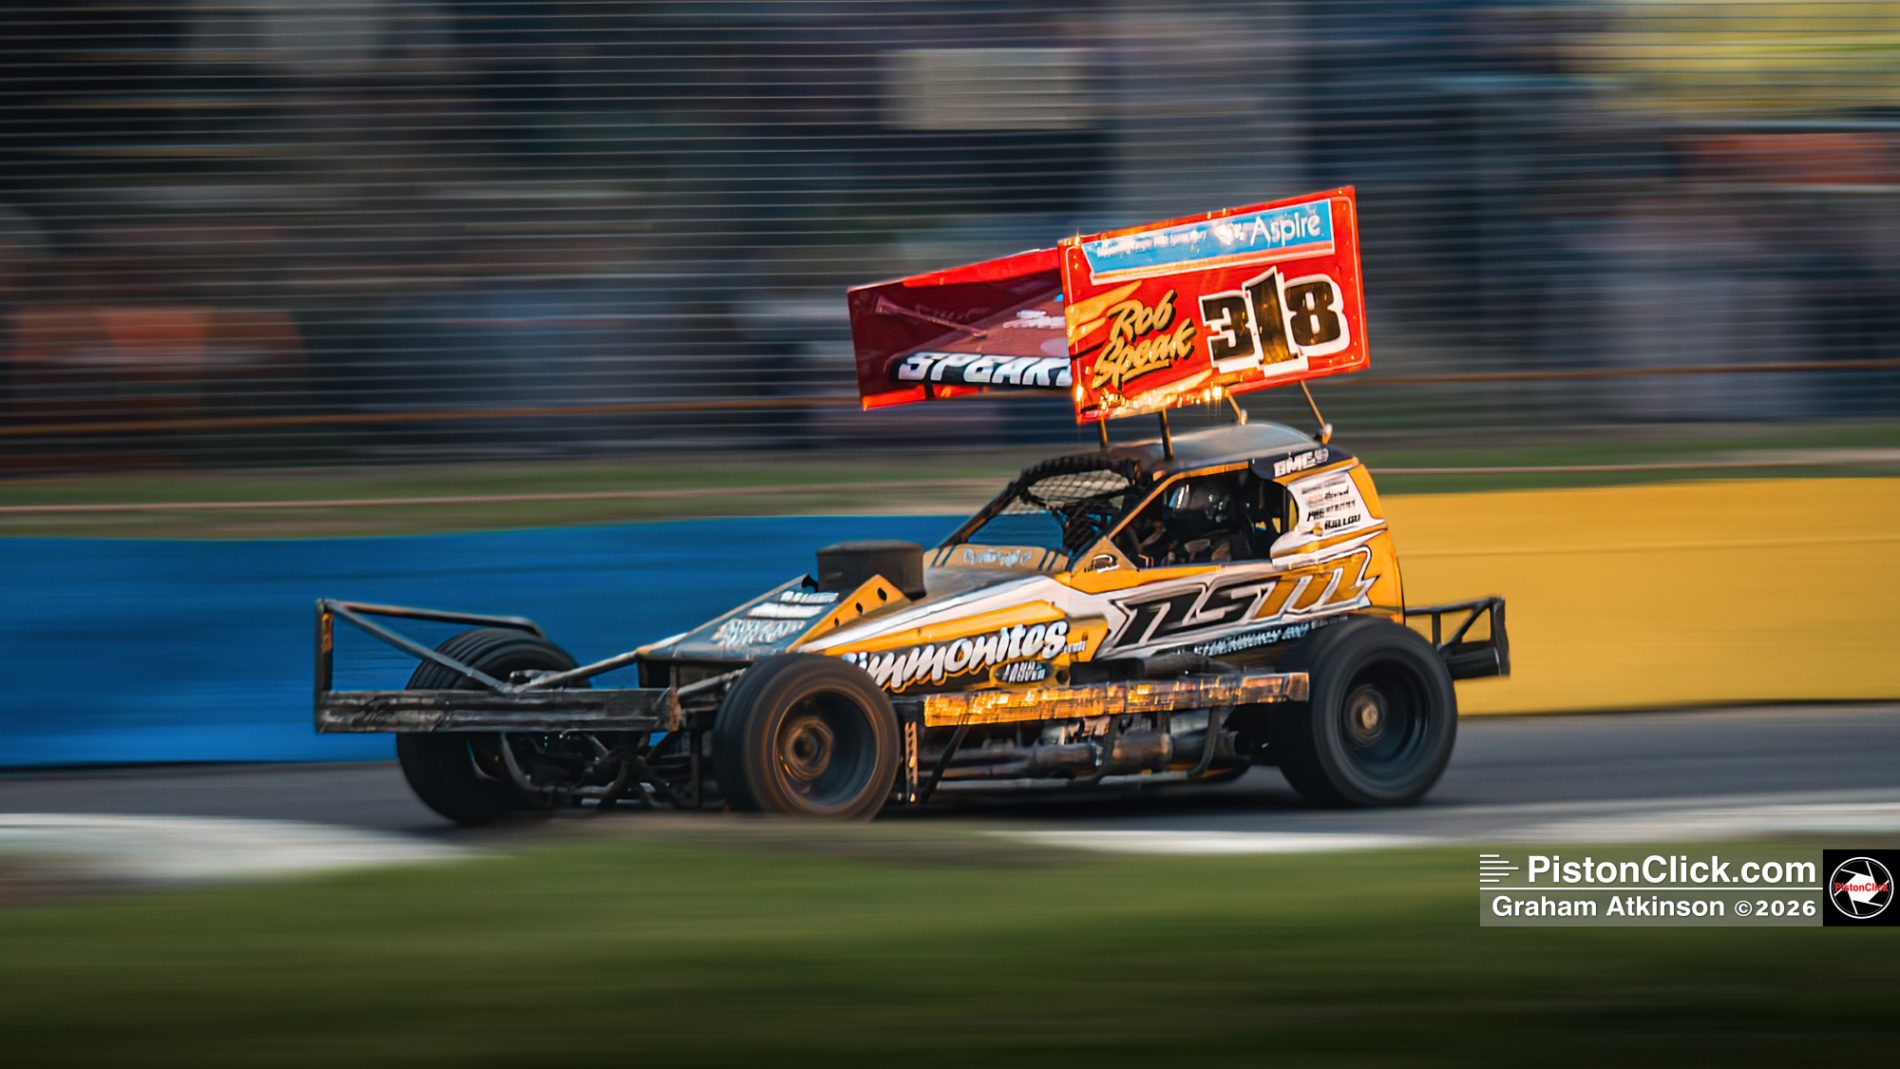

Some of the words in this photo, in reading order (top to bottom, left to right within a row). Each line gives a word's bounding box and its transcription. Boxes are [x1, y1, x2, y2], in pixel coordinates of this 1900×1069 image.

[1249, 209, 1321, 247] Aspire
[1106, 291, 1177, 343] Rob
[1200, 267, 1351, 377] 318
[1091, 319, 1198, 391] Speak
